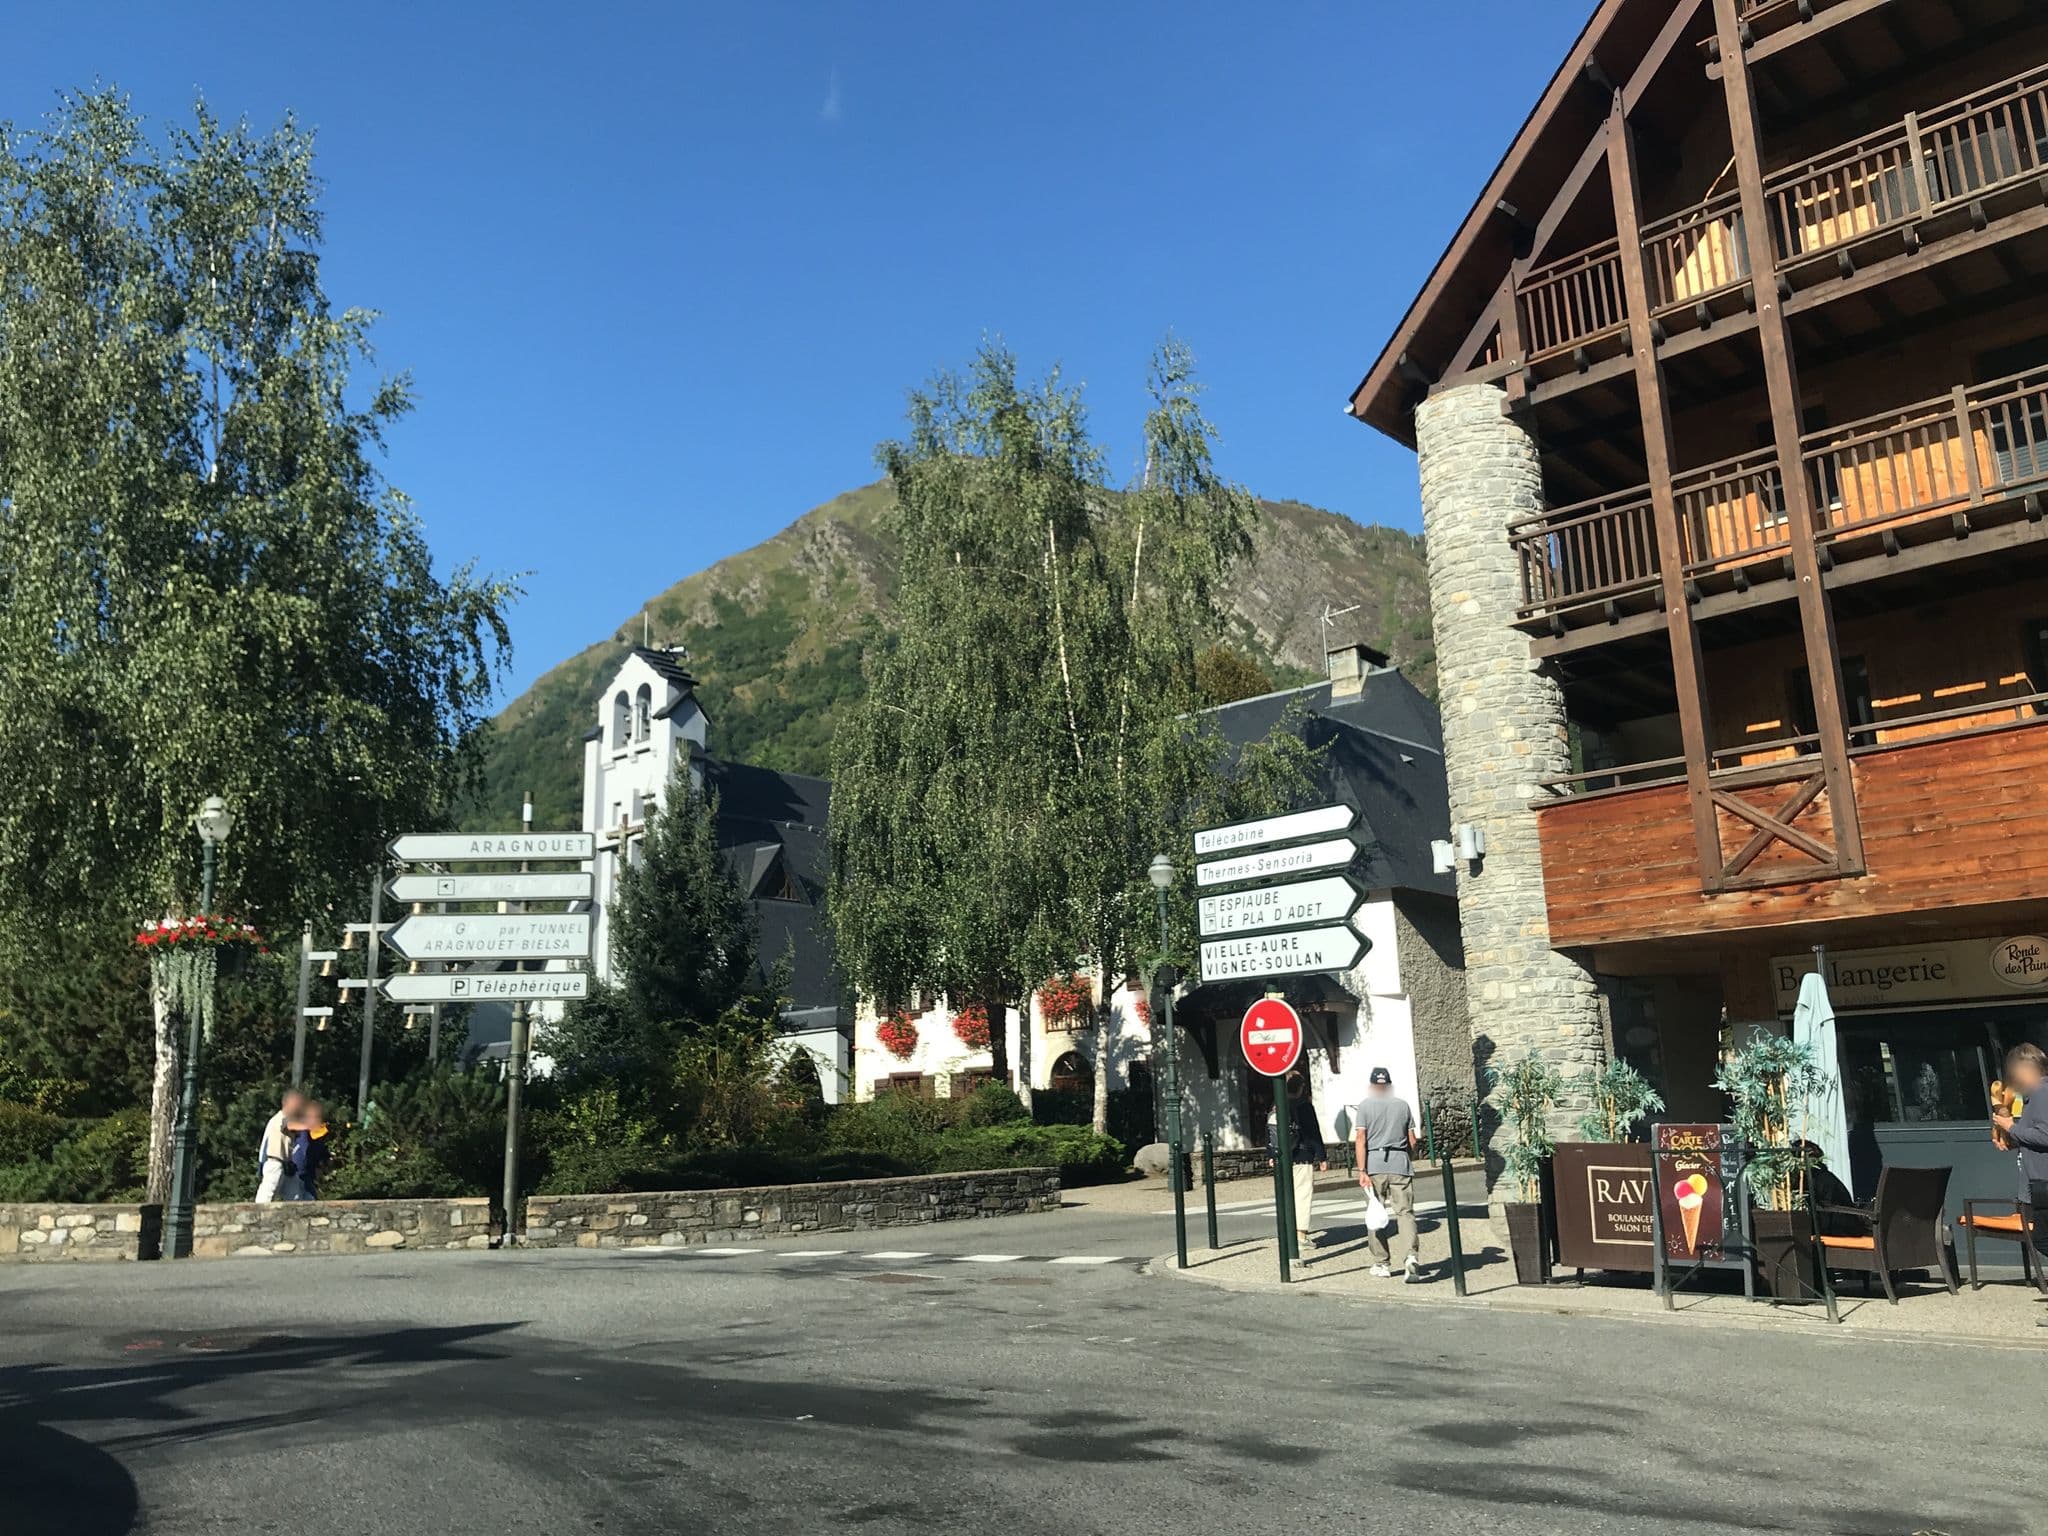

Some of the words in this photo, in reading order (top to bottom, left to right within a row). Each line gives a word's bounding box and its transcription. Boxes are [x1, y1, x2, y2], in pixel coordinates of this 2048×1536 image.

[470, 839, 586, 853] ARAGNOUET
[1202, 851, 1313, 881] Thermes-Sensoria
[1219, 891, 1279, 912] ESPIAUBE
[1221, 915, 1234, 928] LE
[1242, 911, 1265, 926] PLA
[499, 925, 521, 937] par
[530, 922, 584, 934] TUNNEL
[424, 939, 570, 951] ARAGNOUET-BIELSA
[1205, 937, 1299, 960] VIELLE-AURE
[1206, 952, 1322, 975] VIGNEC-SOULAN
[2005, 962, 2022, 974] des
[2019, 956, 2048, 975] Pain
[1778, 957, 1946, 992] Blangerie
[454, 980, 466, 993] P
[476, 978, 581, 995] Téléphérique
[1671, 1135, 1703, 1147] CARTE
[1595, 1178, 1654, 1204] RAV
[1614, 1223, 1641, 1233] SALON
[1642, 1224, 1653, 1233] DE
